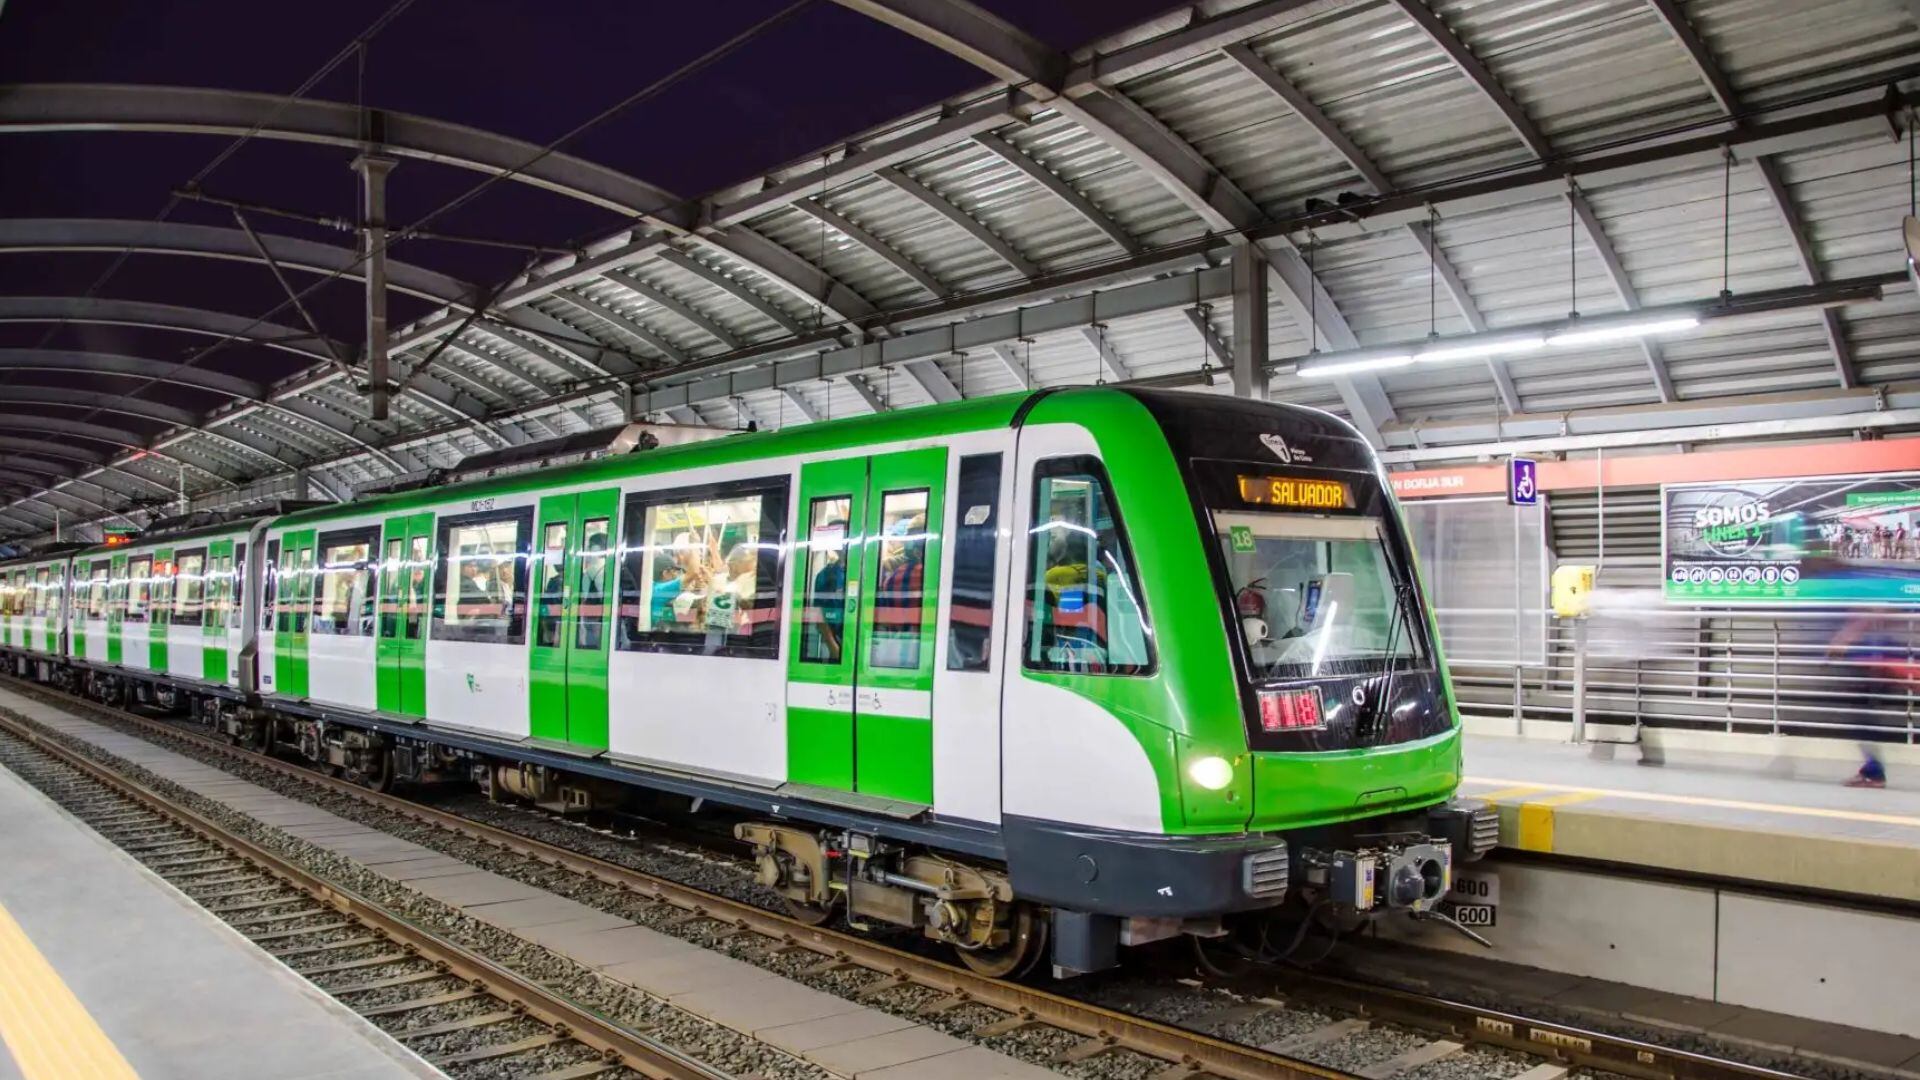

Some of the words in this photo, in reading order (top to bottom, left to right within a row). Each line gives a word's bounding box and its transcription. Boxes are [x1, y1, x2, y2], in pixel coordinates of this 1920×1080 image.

[1404, 477, 1439, 490] BORJA
[1271, 481, 1343, 507] SALVADOR
[1695, 502, 1770, 529] SOMOS
[1233, 529, 1254, 548] 18
[1458, 907, 1488, 923] 600
